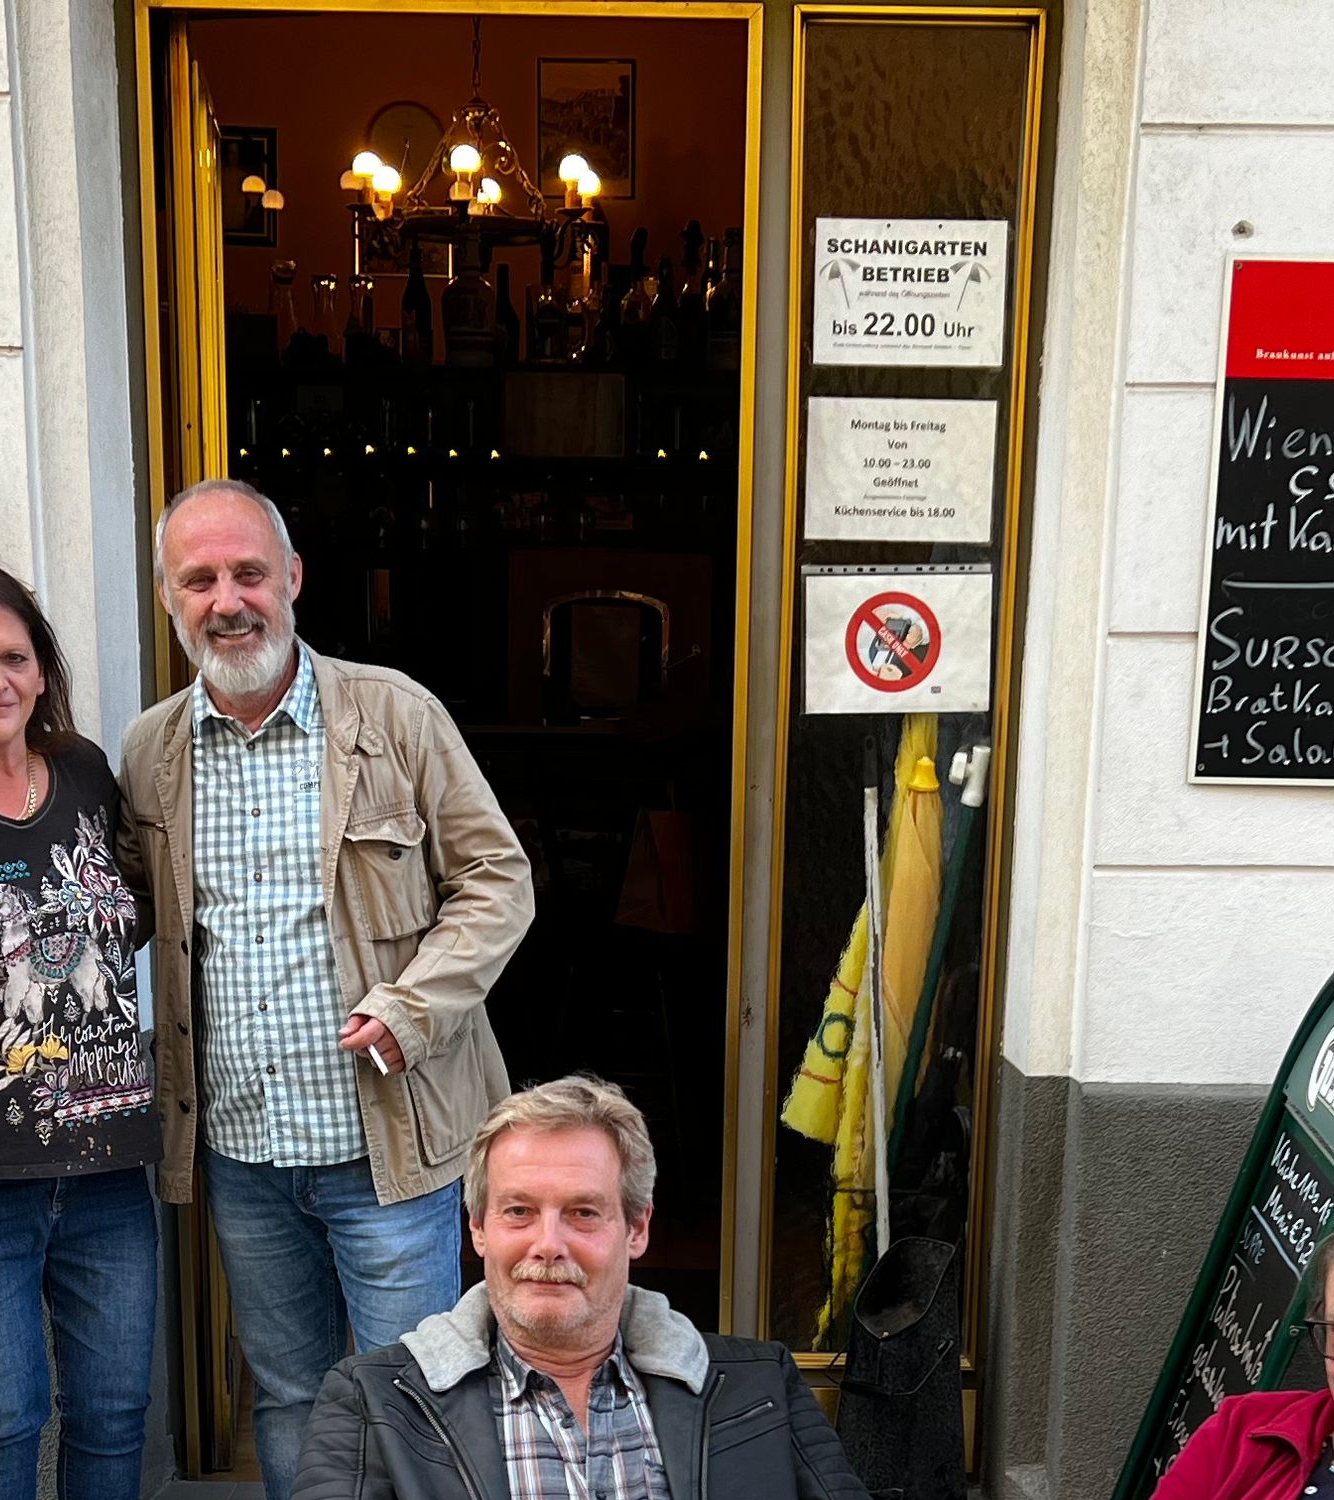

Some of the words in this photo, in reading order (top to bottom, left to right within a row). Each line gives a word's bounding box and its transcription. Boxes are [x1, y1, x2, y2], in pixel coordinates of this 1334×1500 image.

[827, 238, 987, 256] SCHANIGARTEN
[862, 266, 950, 283] BETRIEB
[832, 319, 858, 335] bis
[863, 312, 936, 337] 22.00
[944, 321, 975, 338] Uhr
[1255, 348, 1314, 361] Braukunst
[851, 419, 891, 432] Montag
[893, 420, 908, 431] bis
[910, 420, 947, 433] Freitag
[888, 439, 908, 450] Von
[863, 457, 892, 469] 10.00
[902, 458, 931, 469] 23.00
[873, 477, 919, 488] Geöffnet
[834, 505, 907, 518] Küchenservice
[909, 507, 925, 518] bis
[927, 507, 956, 518] 18.00
[1216, 502, 1278, 550] mit
[878, 626, 896, 646] CASH
[892, 641, 909, 658] ONLY
